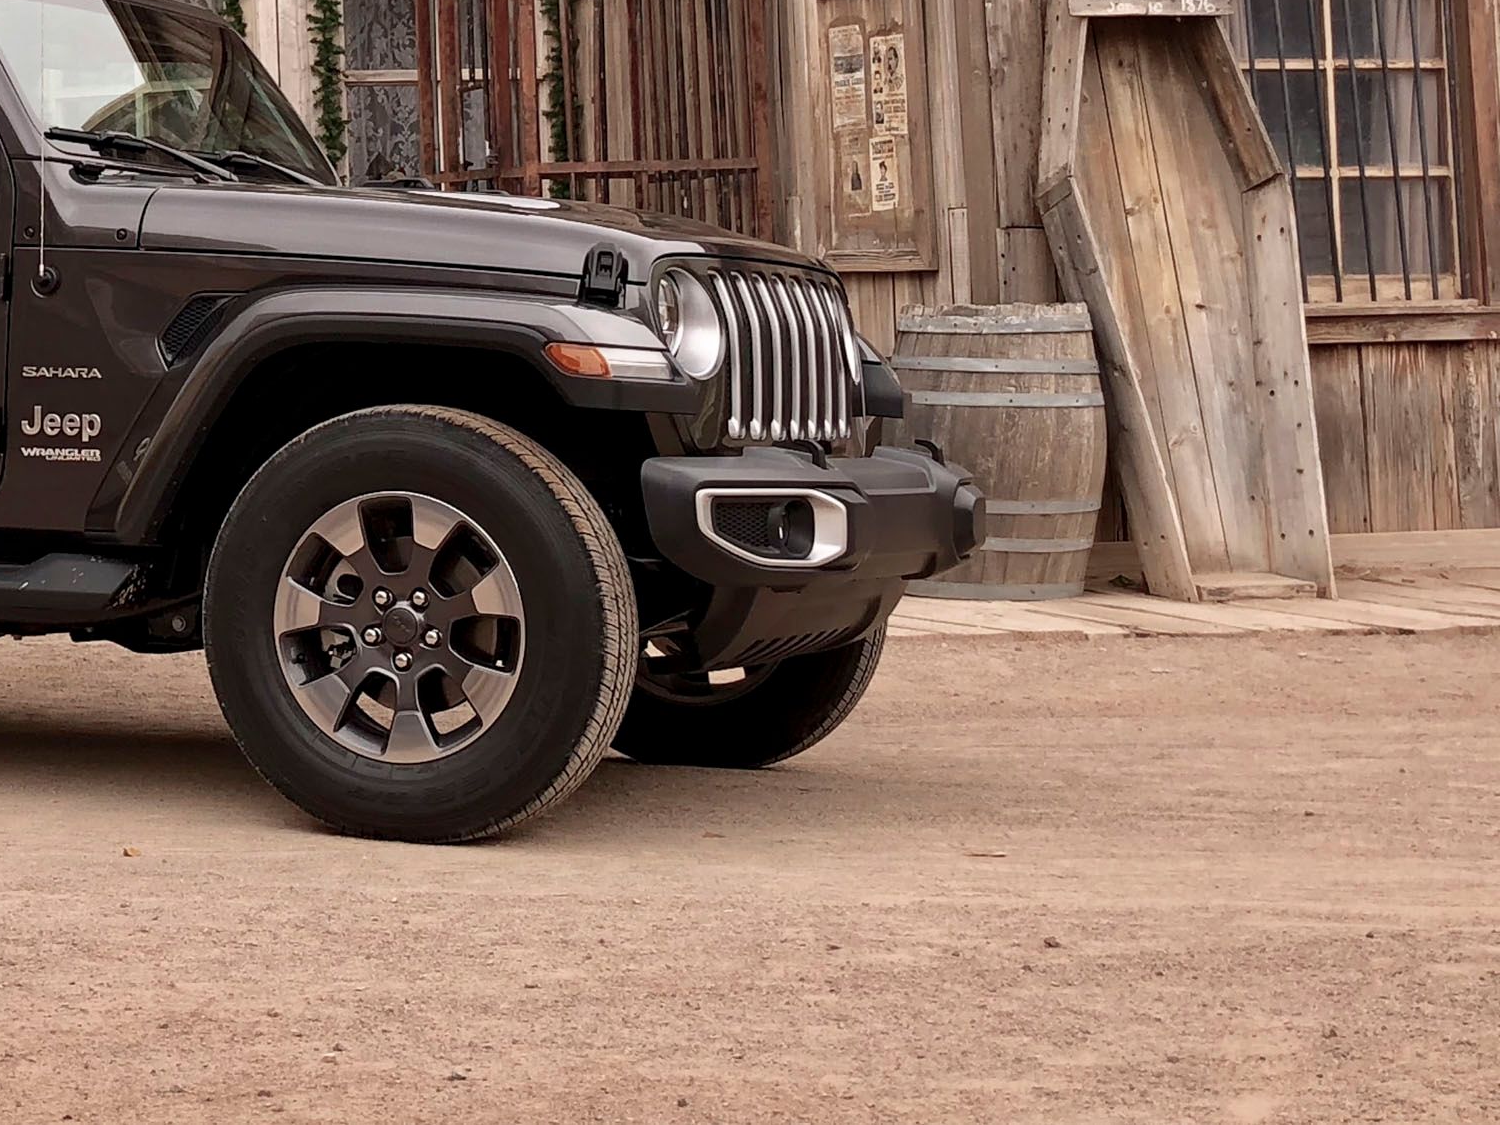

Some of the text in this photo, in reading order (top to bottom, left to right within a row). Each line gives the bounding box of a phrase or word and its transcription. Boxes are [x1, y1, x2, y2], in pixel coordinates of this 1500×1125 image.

[22, 366, 102, 378] SAHARA
[21, 405, 101, 442] Jeep
[20, 446, 101, 457] WRANGLER
